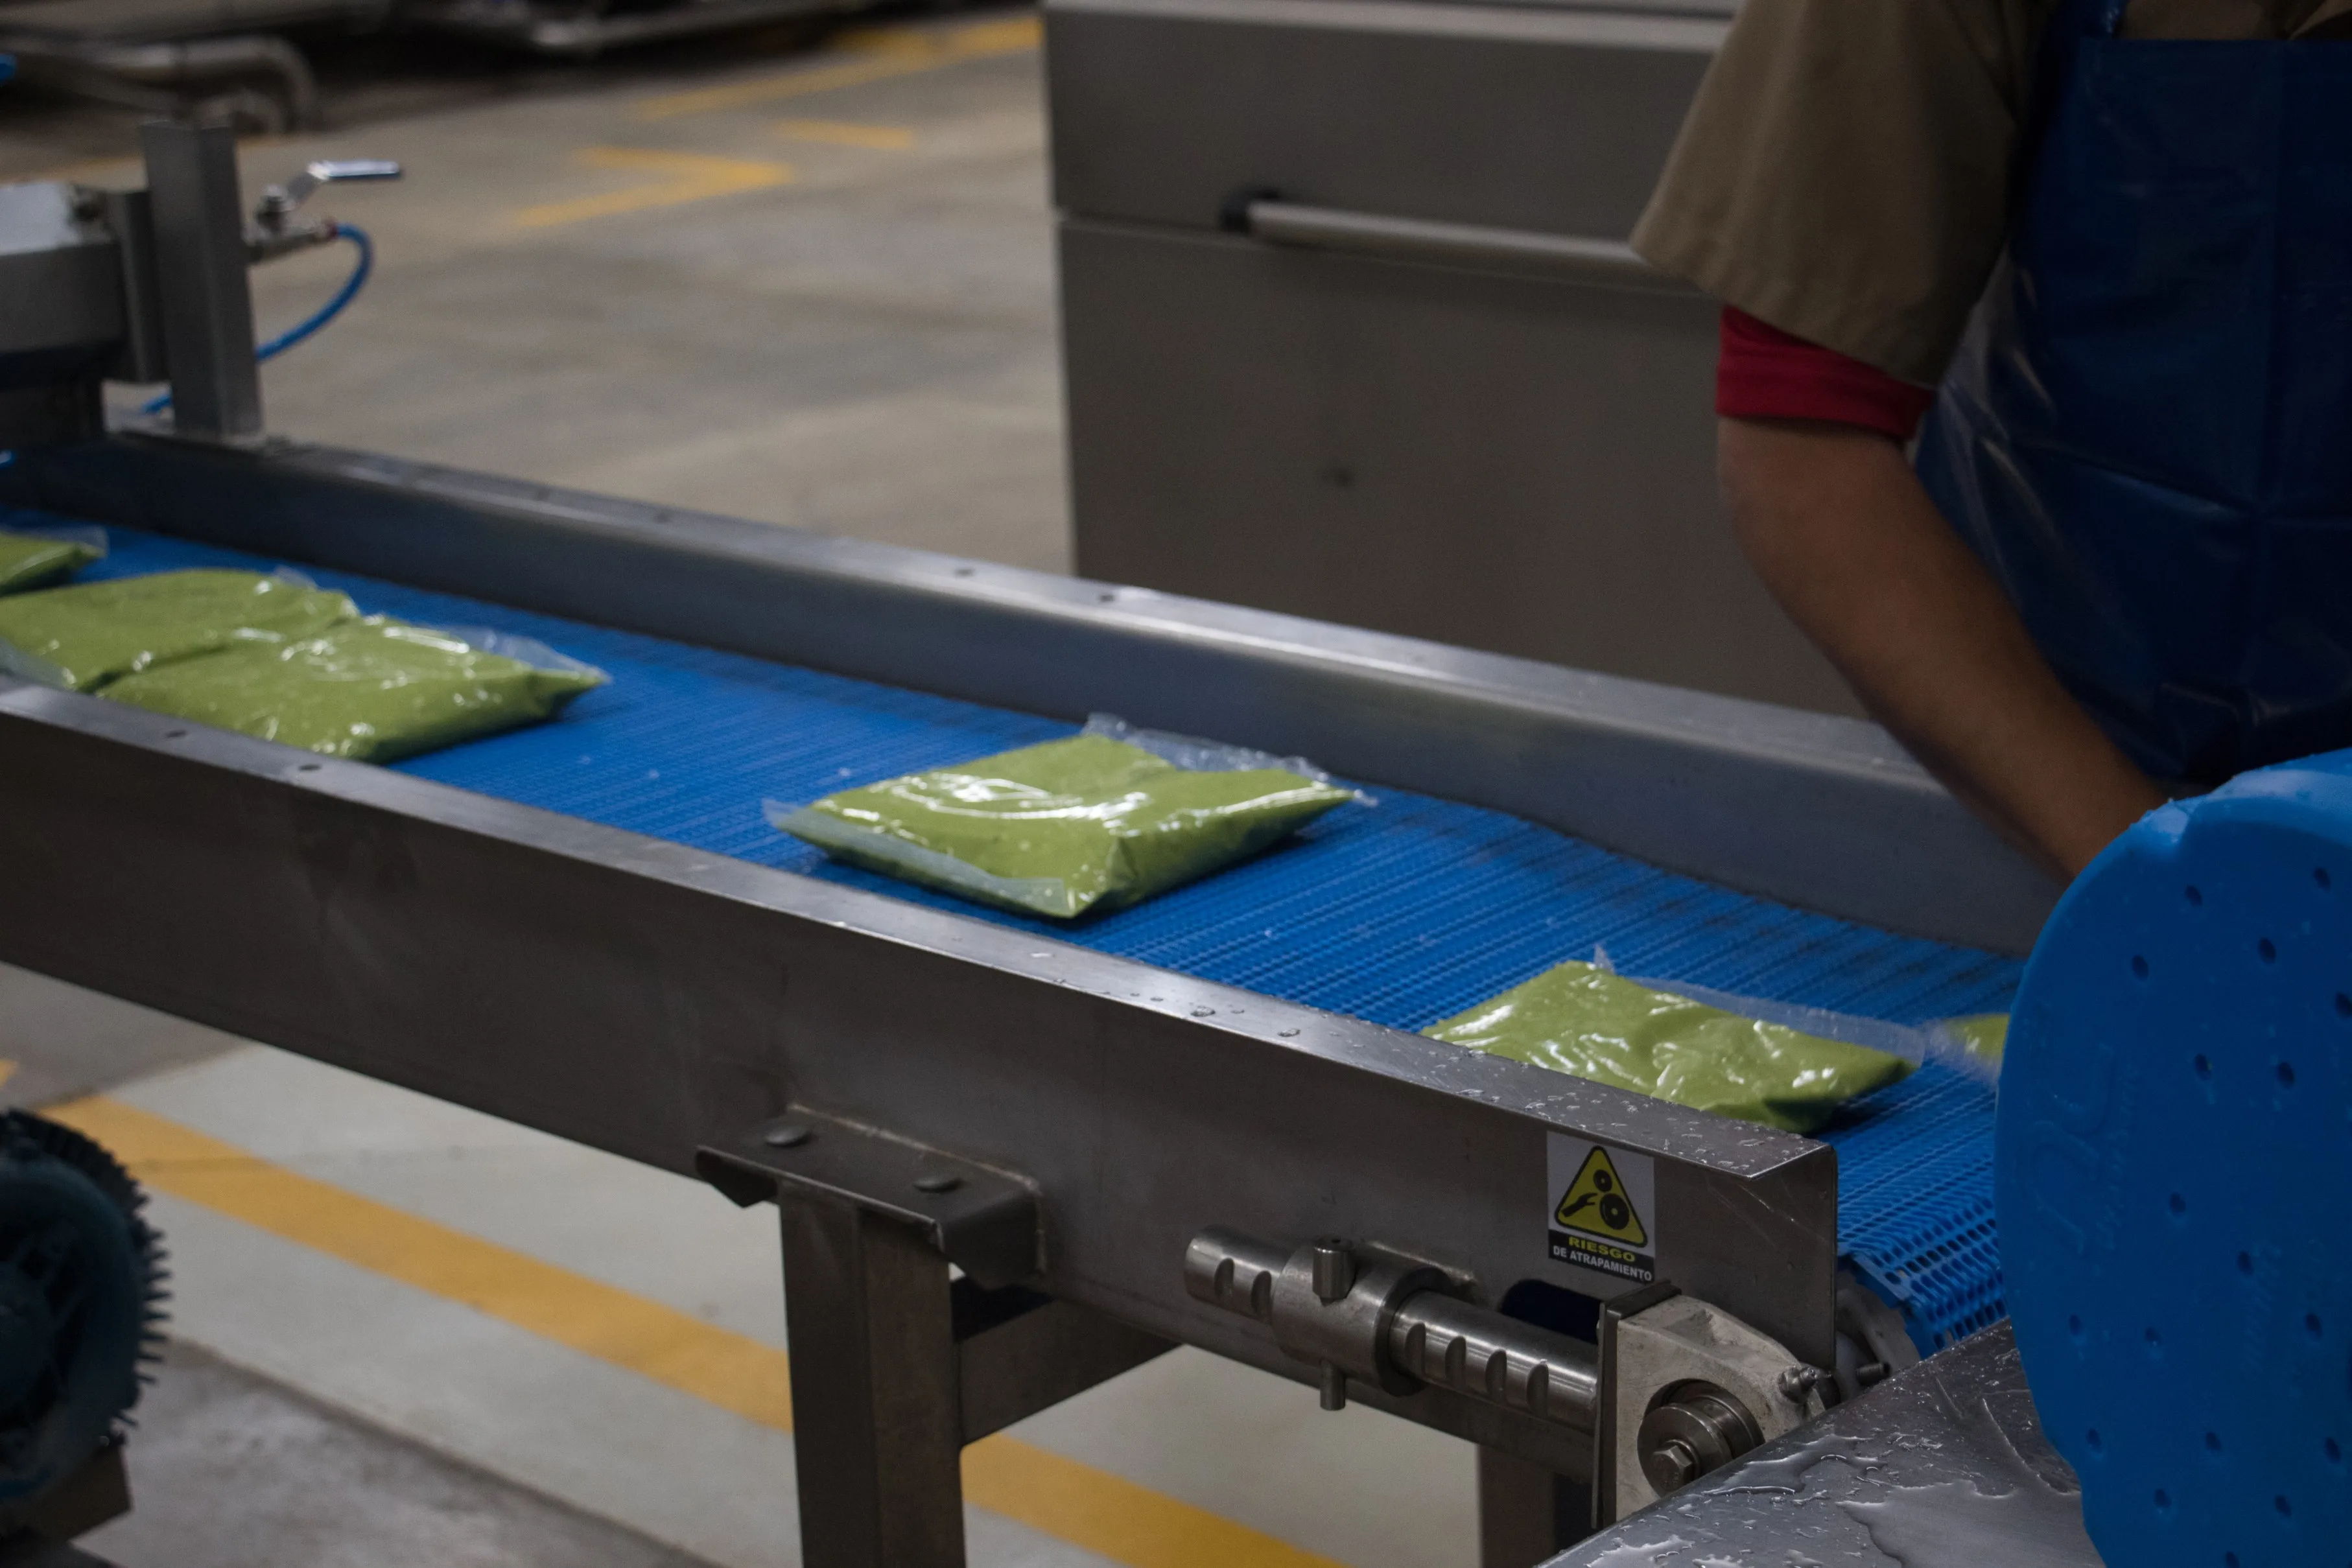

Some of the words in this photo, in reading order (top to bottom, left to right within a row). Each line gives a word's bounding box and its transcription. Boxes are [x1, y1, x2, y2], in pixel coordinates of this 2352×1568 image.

[1553, 1245, 1567, 1258] DE
[1570, 1250, 1652, 1281] ATRAPAMIENTO
[1568, 1236, 1636, 1262] RIESGO
